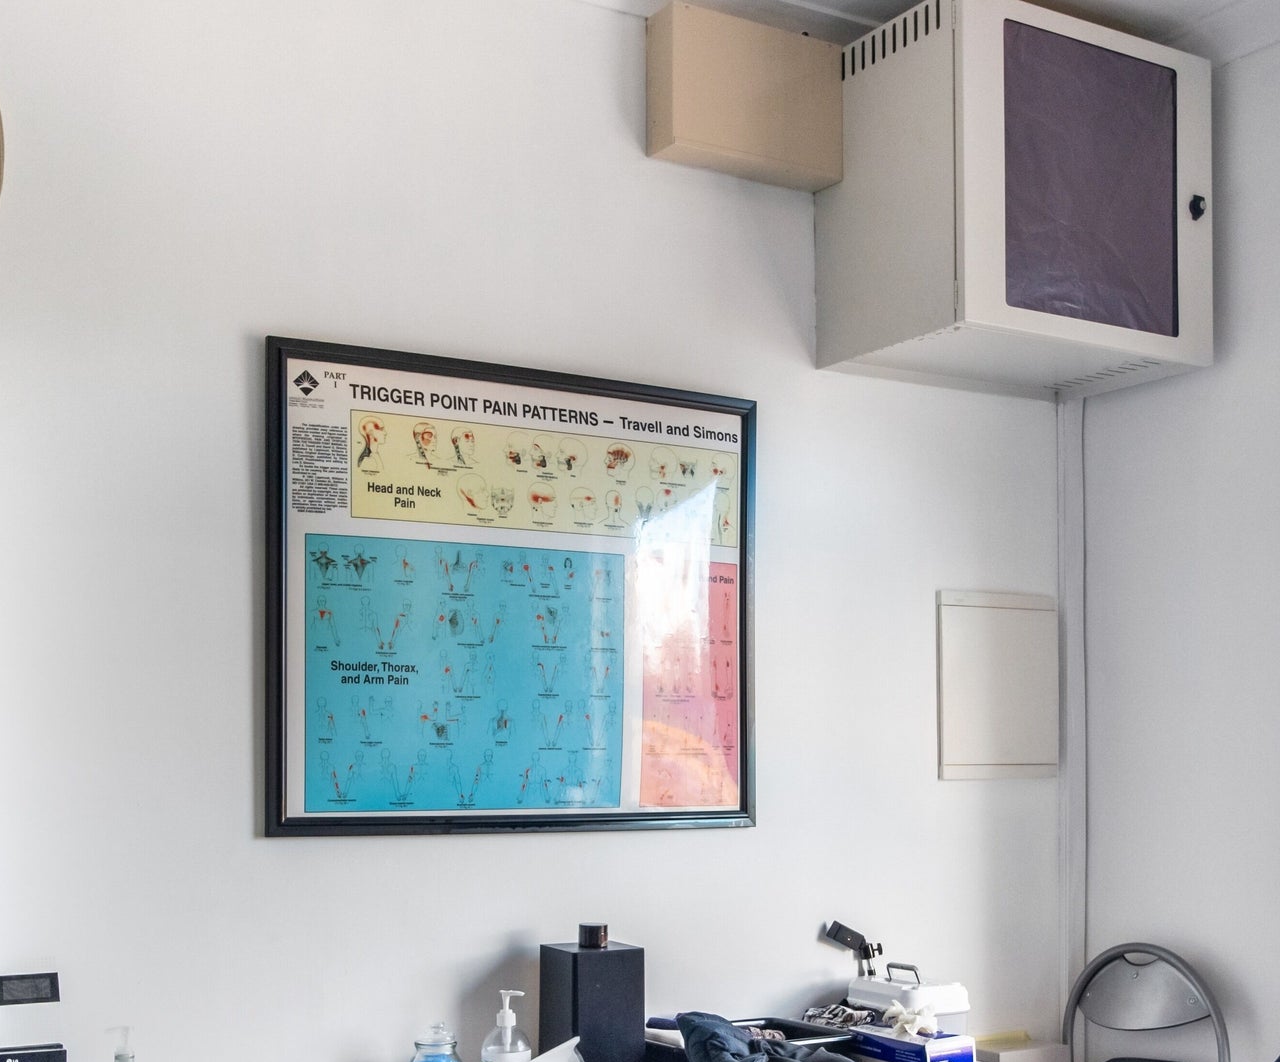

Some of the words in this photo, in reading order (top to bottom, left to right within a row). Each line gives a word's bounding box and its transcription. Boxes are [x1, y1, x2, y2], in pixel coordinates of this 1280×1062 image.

[324, 371, 347, 380] PART
[349, 383, 425, 406] TRIGGER
[431, 394, 478, 412] POINT
[483, 400, 518, 417] PAIN
[522, 403, 599, 426] PATTERNS
[620, 416, 662, 434] Travell
[666, 424, 690, 437] and
[693, 425, 738, 443] Simons
[367, 482, 393, 494] Head
[396, 484, 415, 496] and
[417, 485, 441, 498] Neck
[394, 497, 416, 509] Pain
[719, 575, 734, 584] Pain
[331, 660, 380, 673] Shoulder,
[381, 661, 419, 674] Thorax,
[341, 674, 360, 684] and
[363, 674, 384, 684] Arm
[387, 674, 409, 685] Pain
